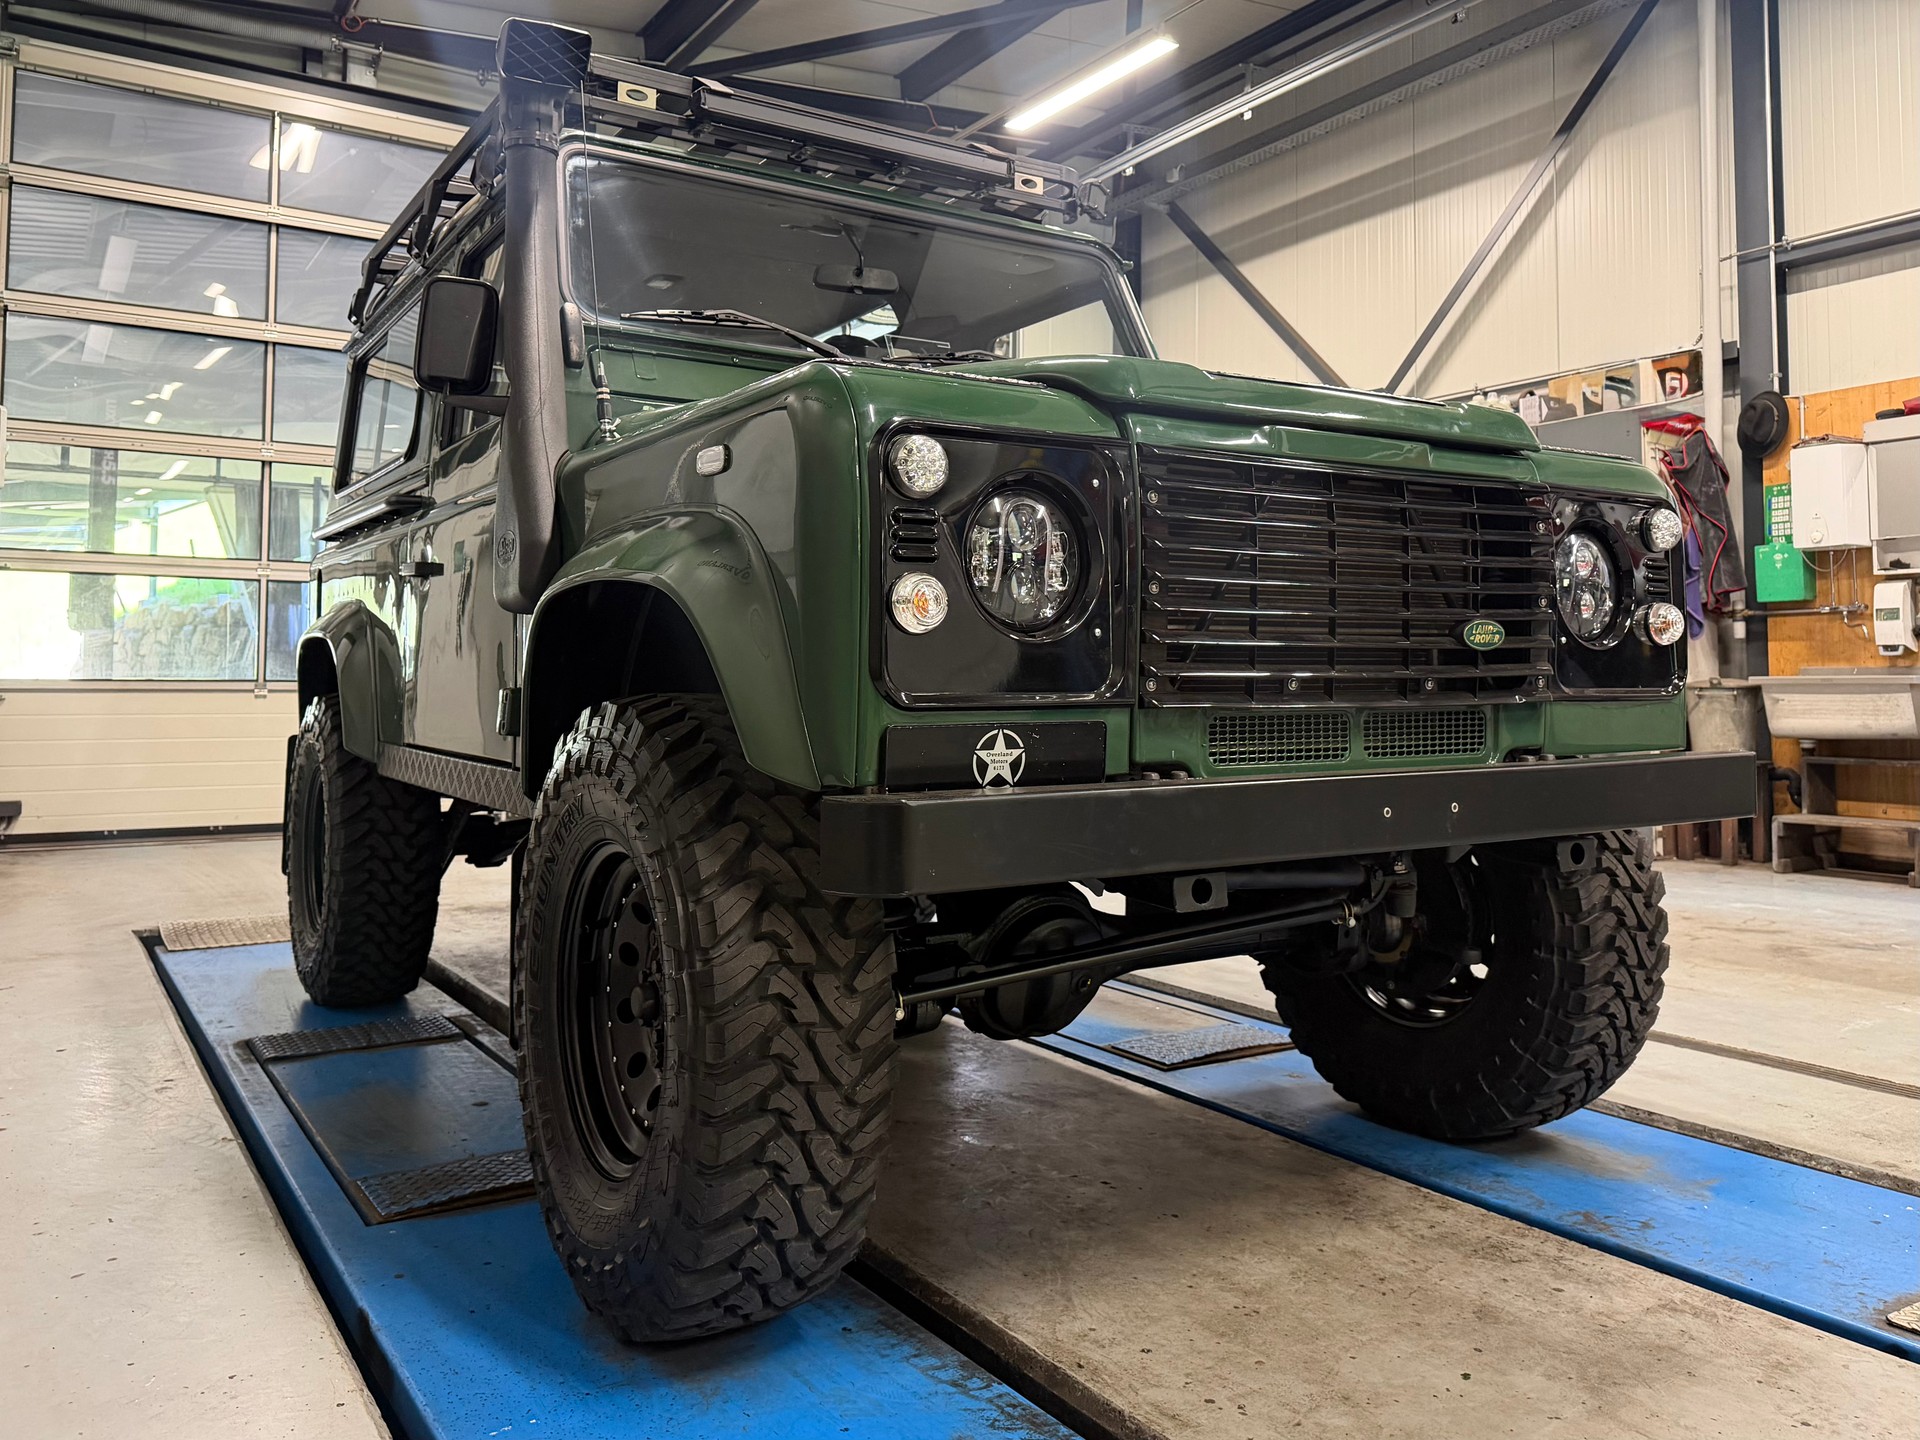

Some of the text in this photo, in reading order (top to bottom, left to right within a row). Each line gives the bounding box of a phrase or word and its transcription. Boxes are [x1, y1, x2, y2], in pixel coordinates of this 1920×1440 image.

[1472, 625, 1494, 634] LAND
[1474, 634, 1500, 643] ROVER
[529, 793, 585, 984] COUNTRY
